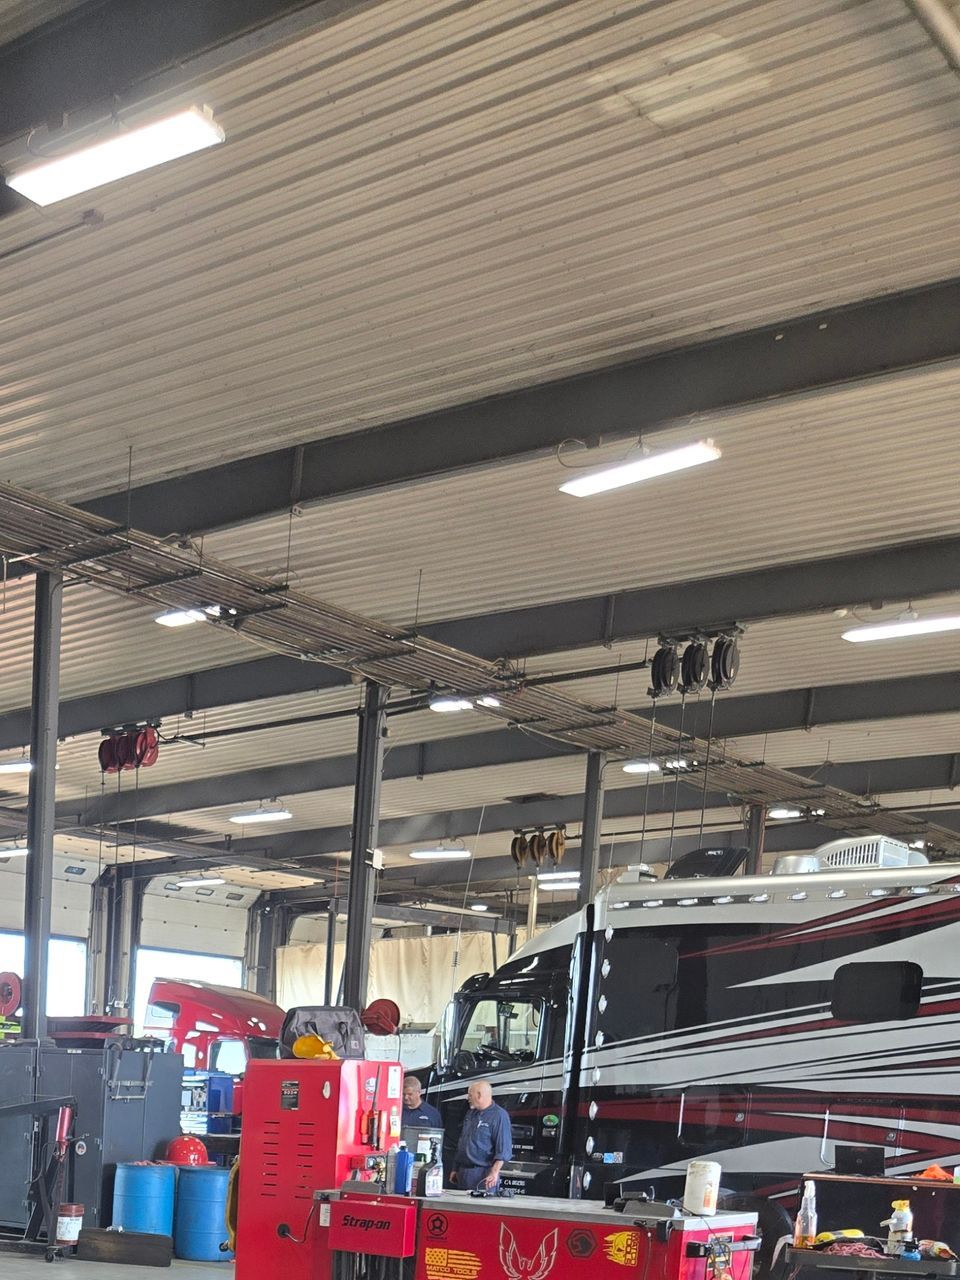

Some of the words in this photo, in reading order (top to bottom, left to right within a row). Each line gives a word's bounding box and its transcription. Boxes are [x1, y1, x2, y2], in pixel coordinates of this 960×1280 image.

[342, 1215, 391, 1231] Strap-on
[630, 1231, 639, 1266] MATCO
[426, 1265, 451, 1273] MATCO
[452, 1267, 477, 1276] TOOLS
